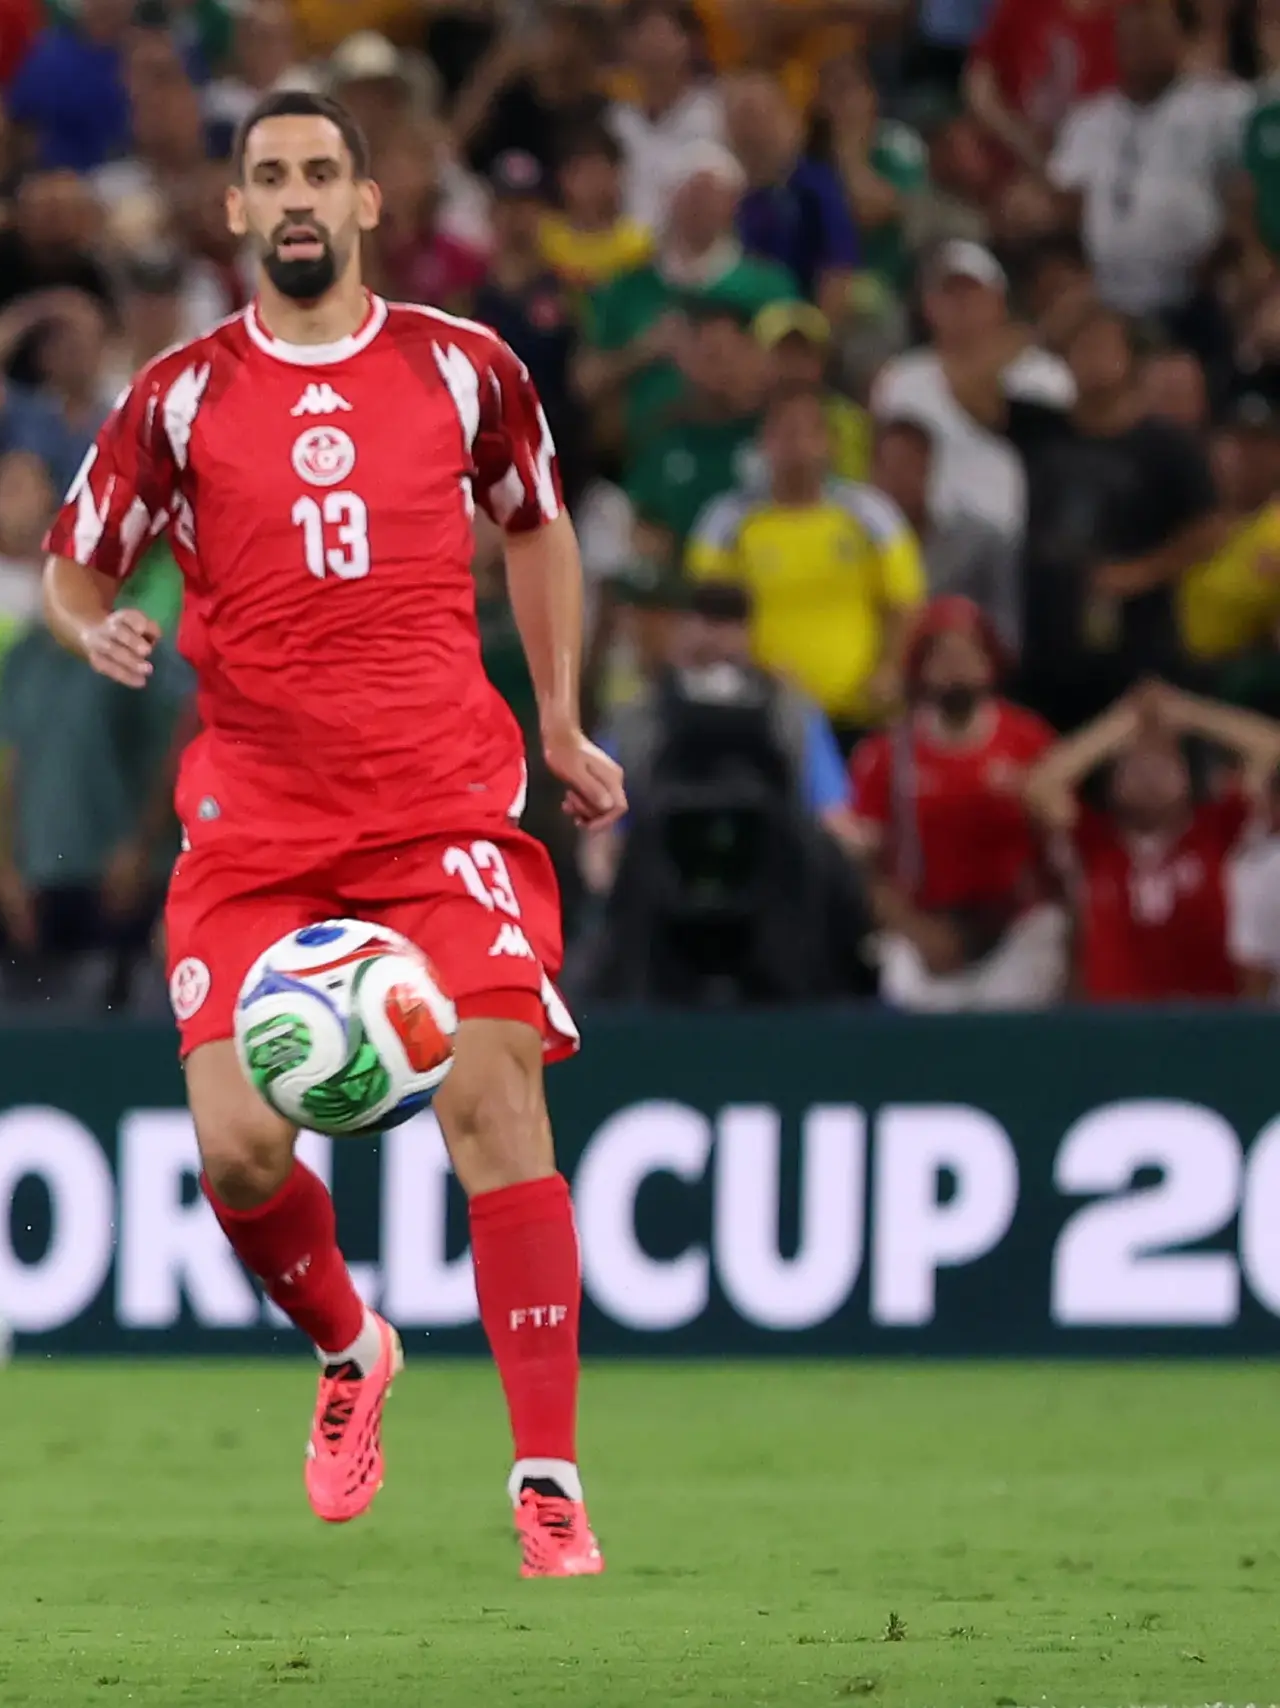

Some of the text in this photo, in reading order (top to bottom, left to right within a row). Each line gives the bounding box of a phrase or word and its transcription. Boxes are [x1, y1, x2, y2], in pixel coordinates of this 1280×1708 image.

[290, 490, 371, 580] 13
[442, 839, 522, 920] 13
[573, 1098, 1019, 1331] CUP
[1050, 1098, 1280, 1328] 2
